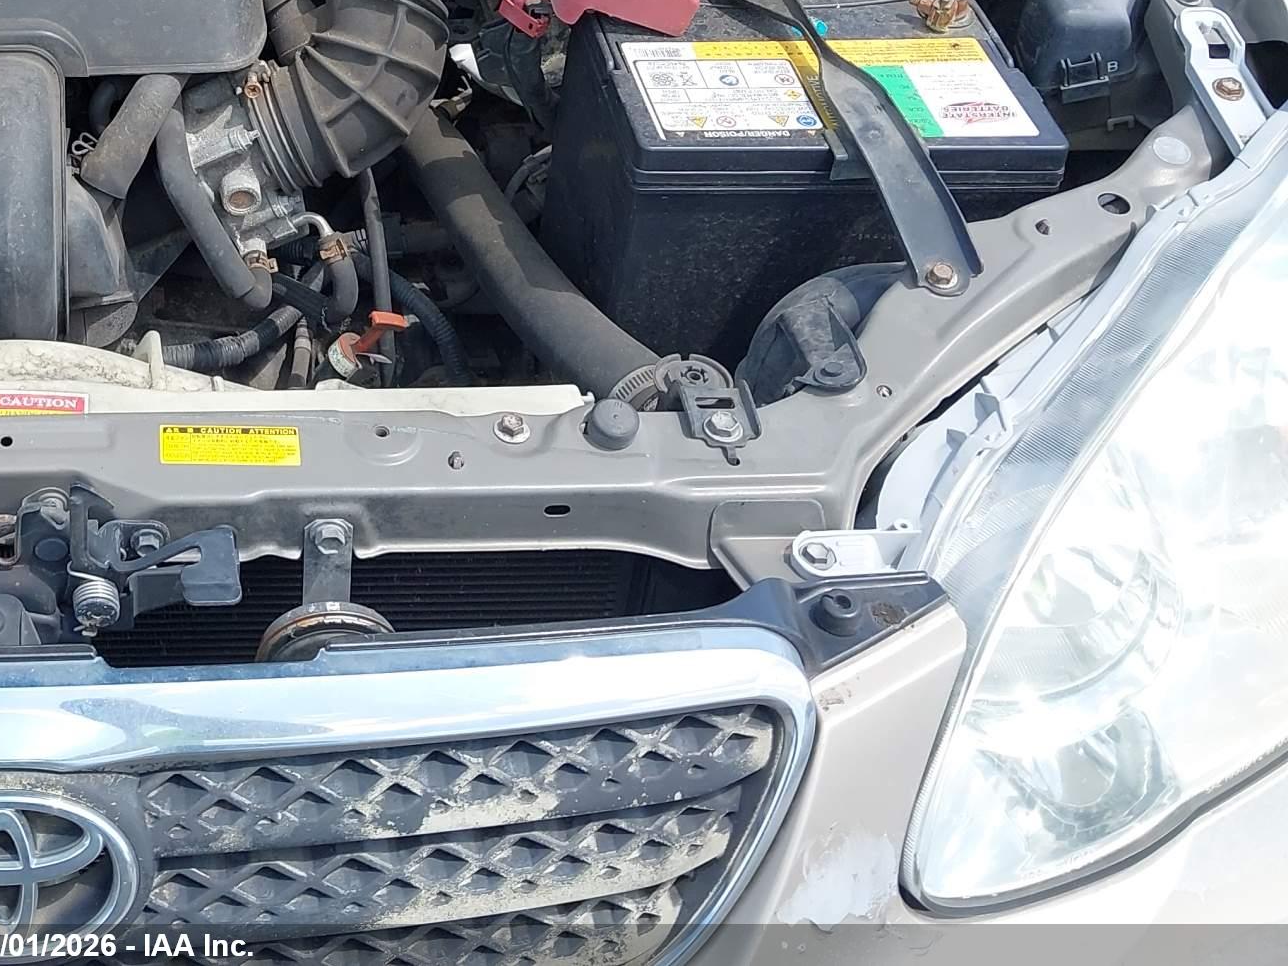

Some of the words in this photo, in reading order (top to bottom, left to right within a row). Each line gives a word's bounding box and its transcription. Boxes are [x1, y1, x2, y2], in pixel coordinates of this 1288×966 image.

[1107, 60, 1118, 73] B
[943, 105, 1010, 113] BATTERIES
[942, 112, 1016, 120] INTERSTATE
[0, 395, 77, 409] CAUTION
[248, 427, 295, 435] ATTENTION
